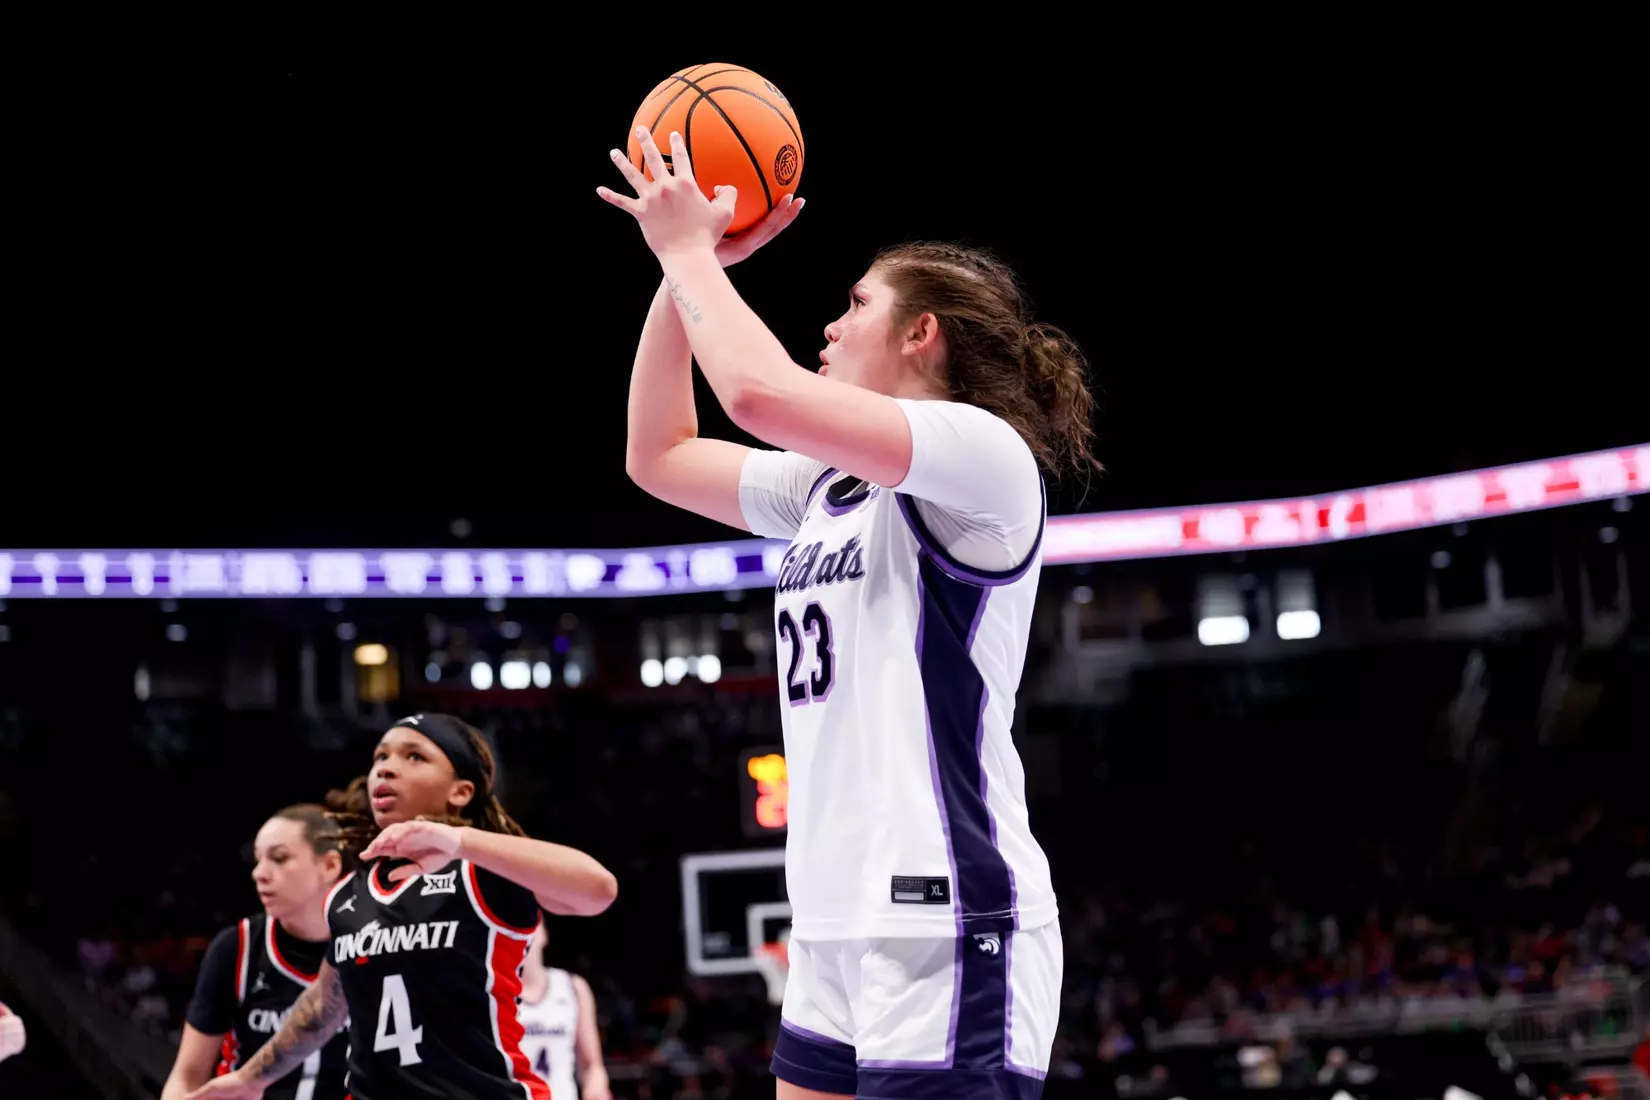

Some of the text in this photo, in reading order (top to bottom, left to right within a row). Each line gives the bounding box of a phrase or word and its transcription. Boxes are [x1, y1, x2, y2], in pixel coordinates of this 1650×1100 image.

[778, 600, 836, 708] 23
[931, 884, 944, 896] XL
[335, 920, 459, 963] CINCINNATI
[373, 973, 423, 1067] 4
